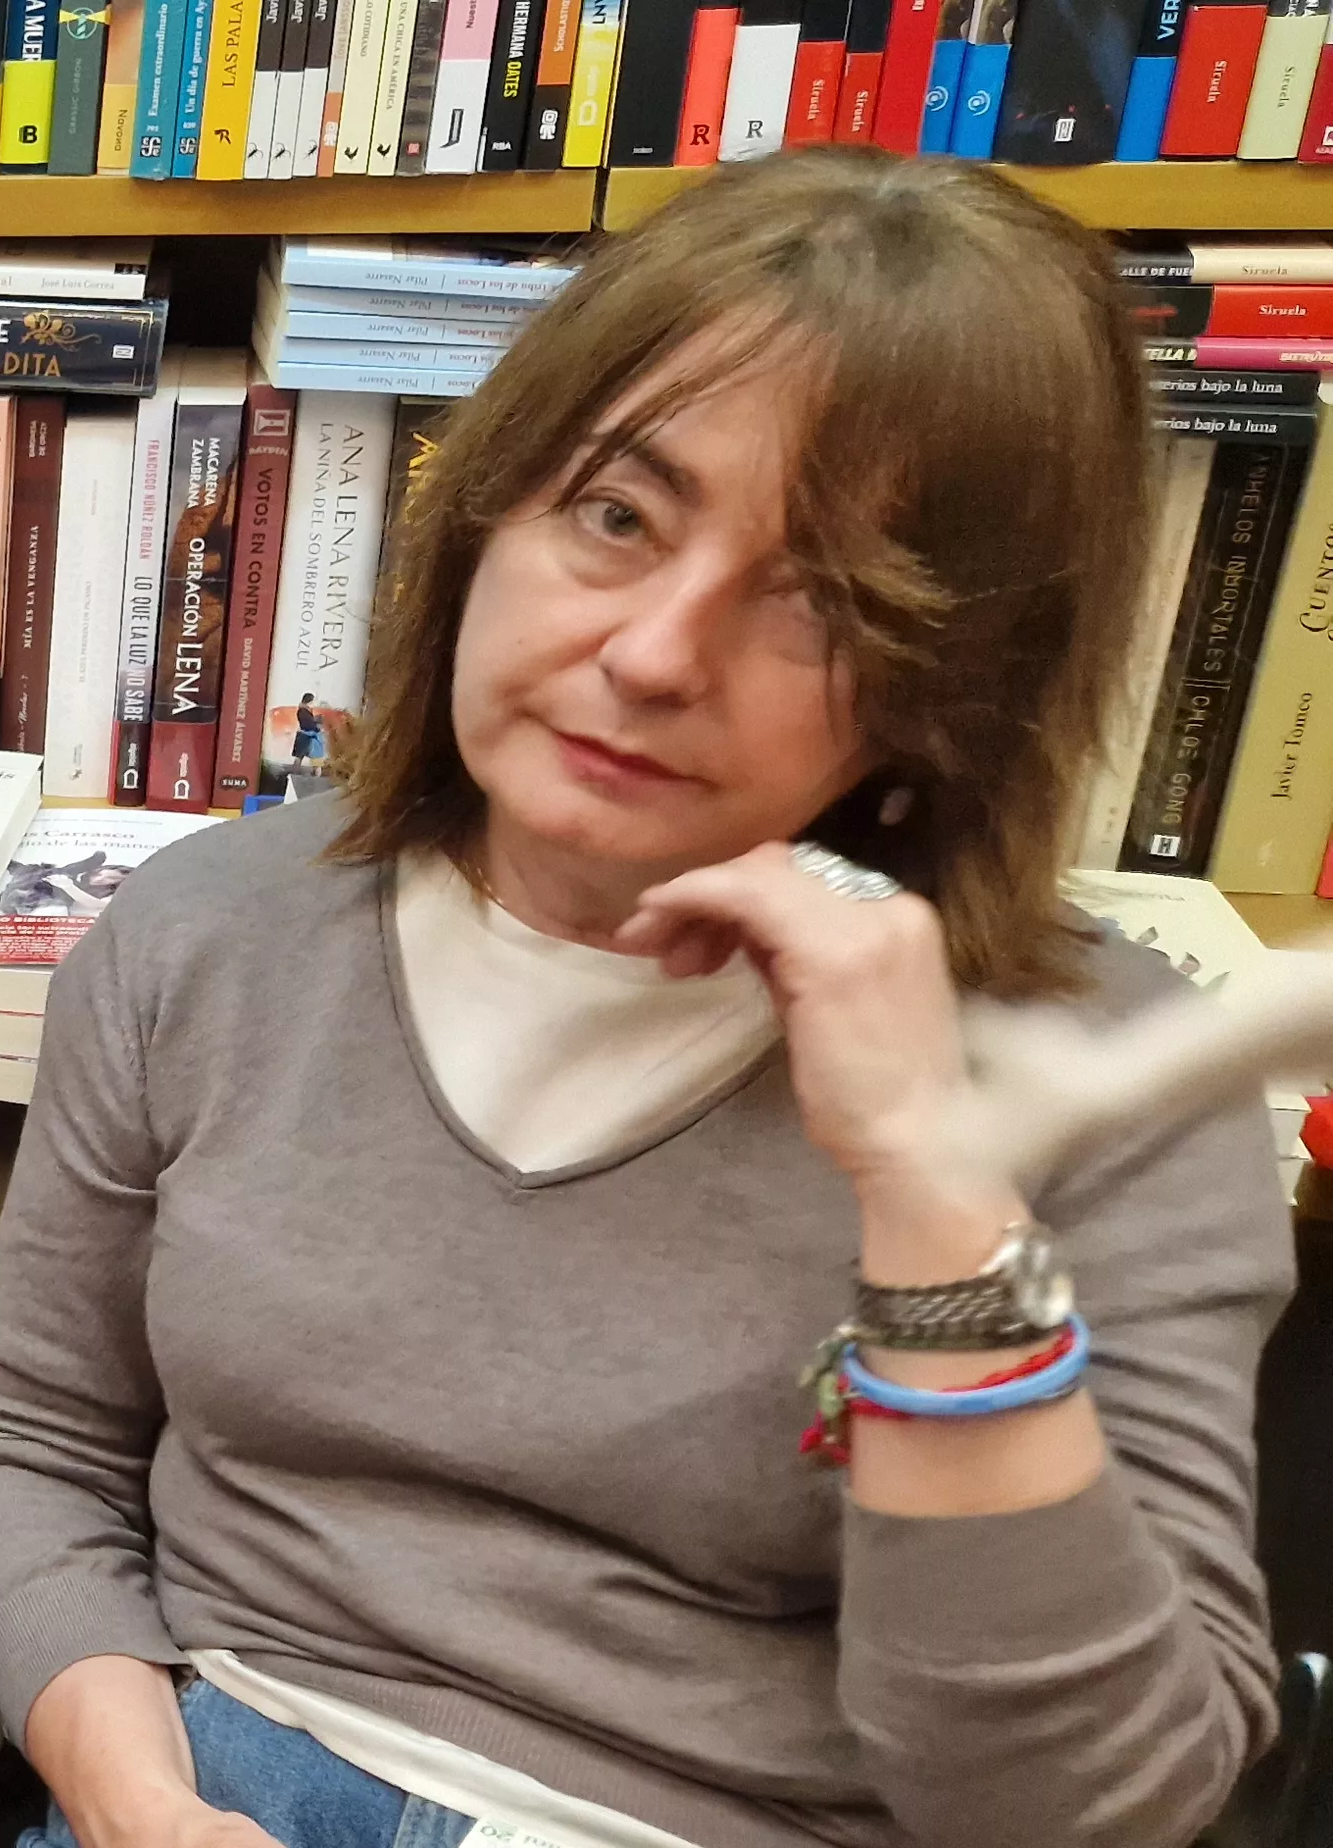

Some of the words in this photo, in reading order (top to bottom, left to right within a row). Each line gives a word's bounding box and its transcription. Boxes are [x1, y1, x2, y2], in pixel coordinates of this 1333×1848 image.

[153, 3, 169, 76] extraordinario
[195, 16, 205, 29] en
[509, 1, 531, 59] HERMANA
[191, 30, 205, 63] guerra
[187, 79, 199, 97] día
[189, 64, 200, 78] de
[503, 61, 521, 98] OATES
[1207, 60, 1227, 103] Siruela
[1277, 66, 1296, 108] Siruela
[148, 78, 162, 117] Examen
[185, 99, 196, 114] Un
[808, 78, 825, 121] Siruela
[851, 90, 869, 133] Siruela
[40, 277, 60, 290] José
[62, 278, 81, 289] Luis
[82, 279, 116, 290] Correa
[1241, 265, 1289, 275] Siruela
[1258, 304, 1307, 316] Siruela
[319, 422, 333, 444] LA
[1194, 417, 1226, 434] bajo
[1228, 417, 1242, 432] la
[1244, 417, 1277, 434] luna
[187, 439, 205, 509] ZAMBRANA
[204, 438, 221, 507] MACARENA
[316, 448, 333, 495] NIÑA
[338, 425, 365, 486] ANA
[254, 468, 274, 527] VOTOS
[310, 497, 326, 528] DEL
[1231, 456, 1270, 545] ANHELOS
[249, 532, 267, 556] EN
[330, 494, 358, 567] LENA
[184, 537, 205, 639] OPERACIÓN
[242, 560, 264, 630] CONTRA
[301, 532, 322, 623] SOMBRERO
[318, 575, 350, 671] RIVERA
[1203, 555, 1247, 673] INMORTALES
[296, 626, 314, 669] AZUL
[171, 643, 200, 715] LENA
[1177, 695, 1211, 760] CHLOE
[1282, 692, 1313, 747] Tomeo
[1270, 745, 1302, 801] Javier
[1162, 772, 1192, 825] GONG
[44, 828, 137, 840] Carrasco
